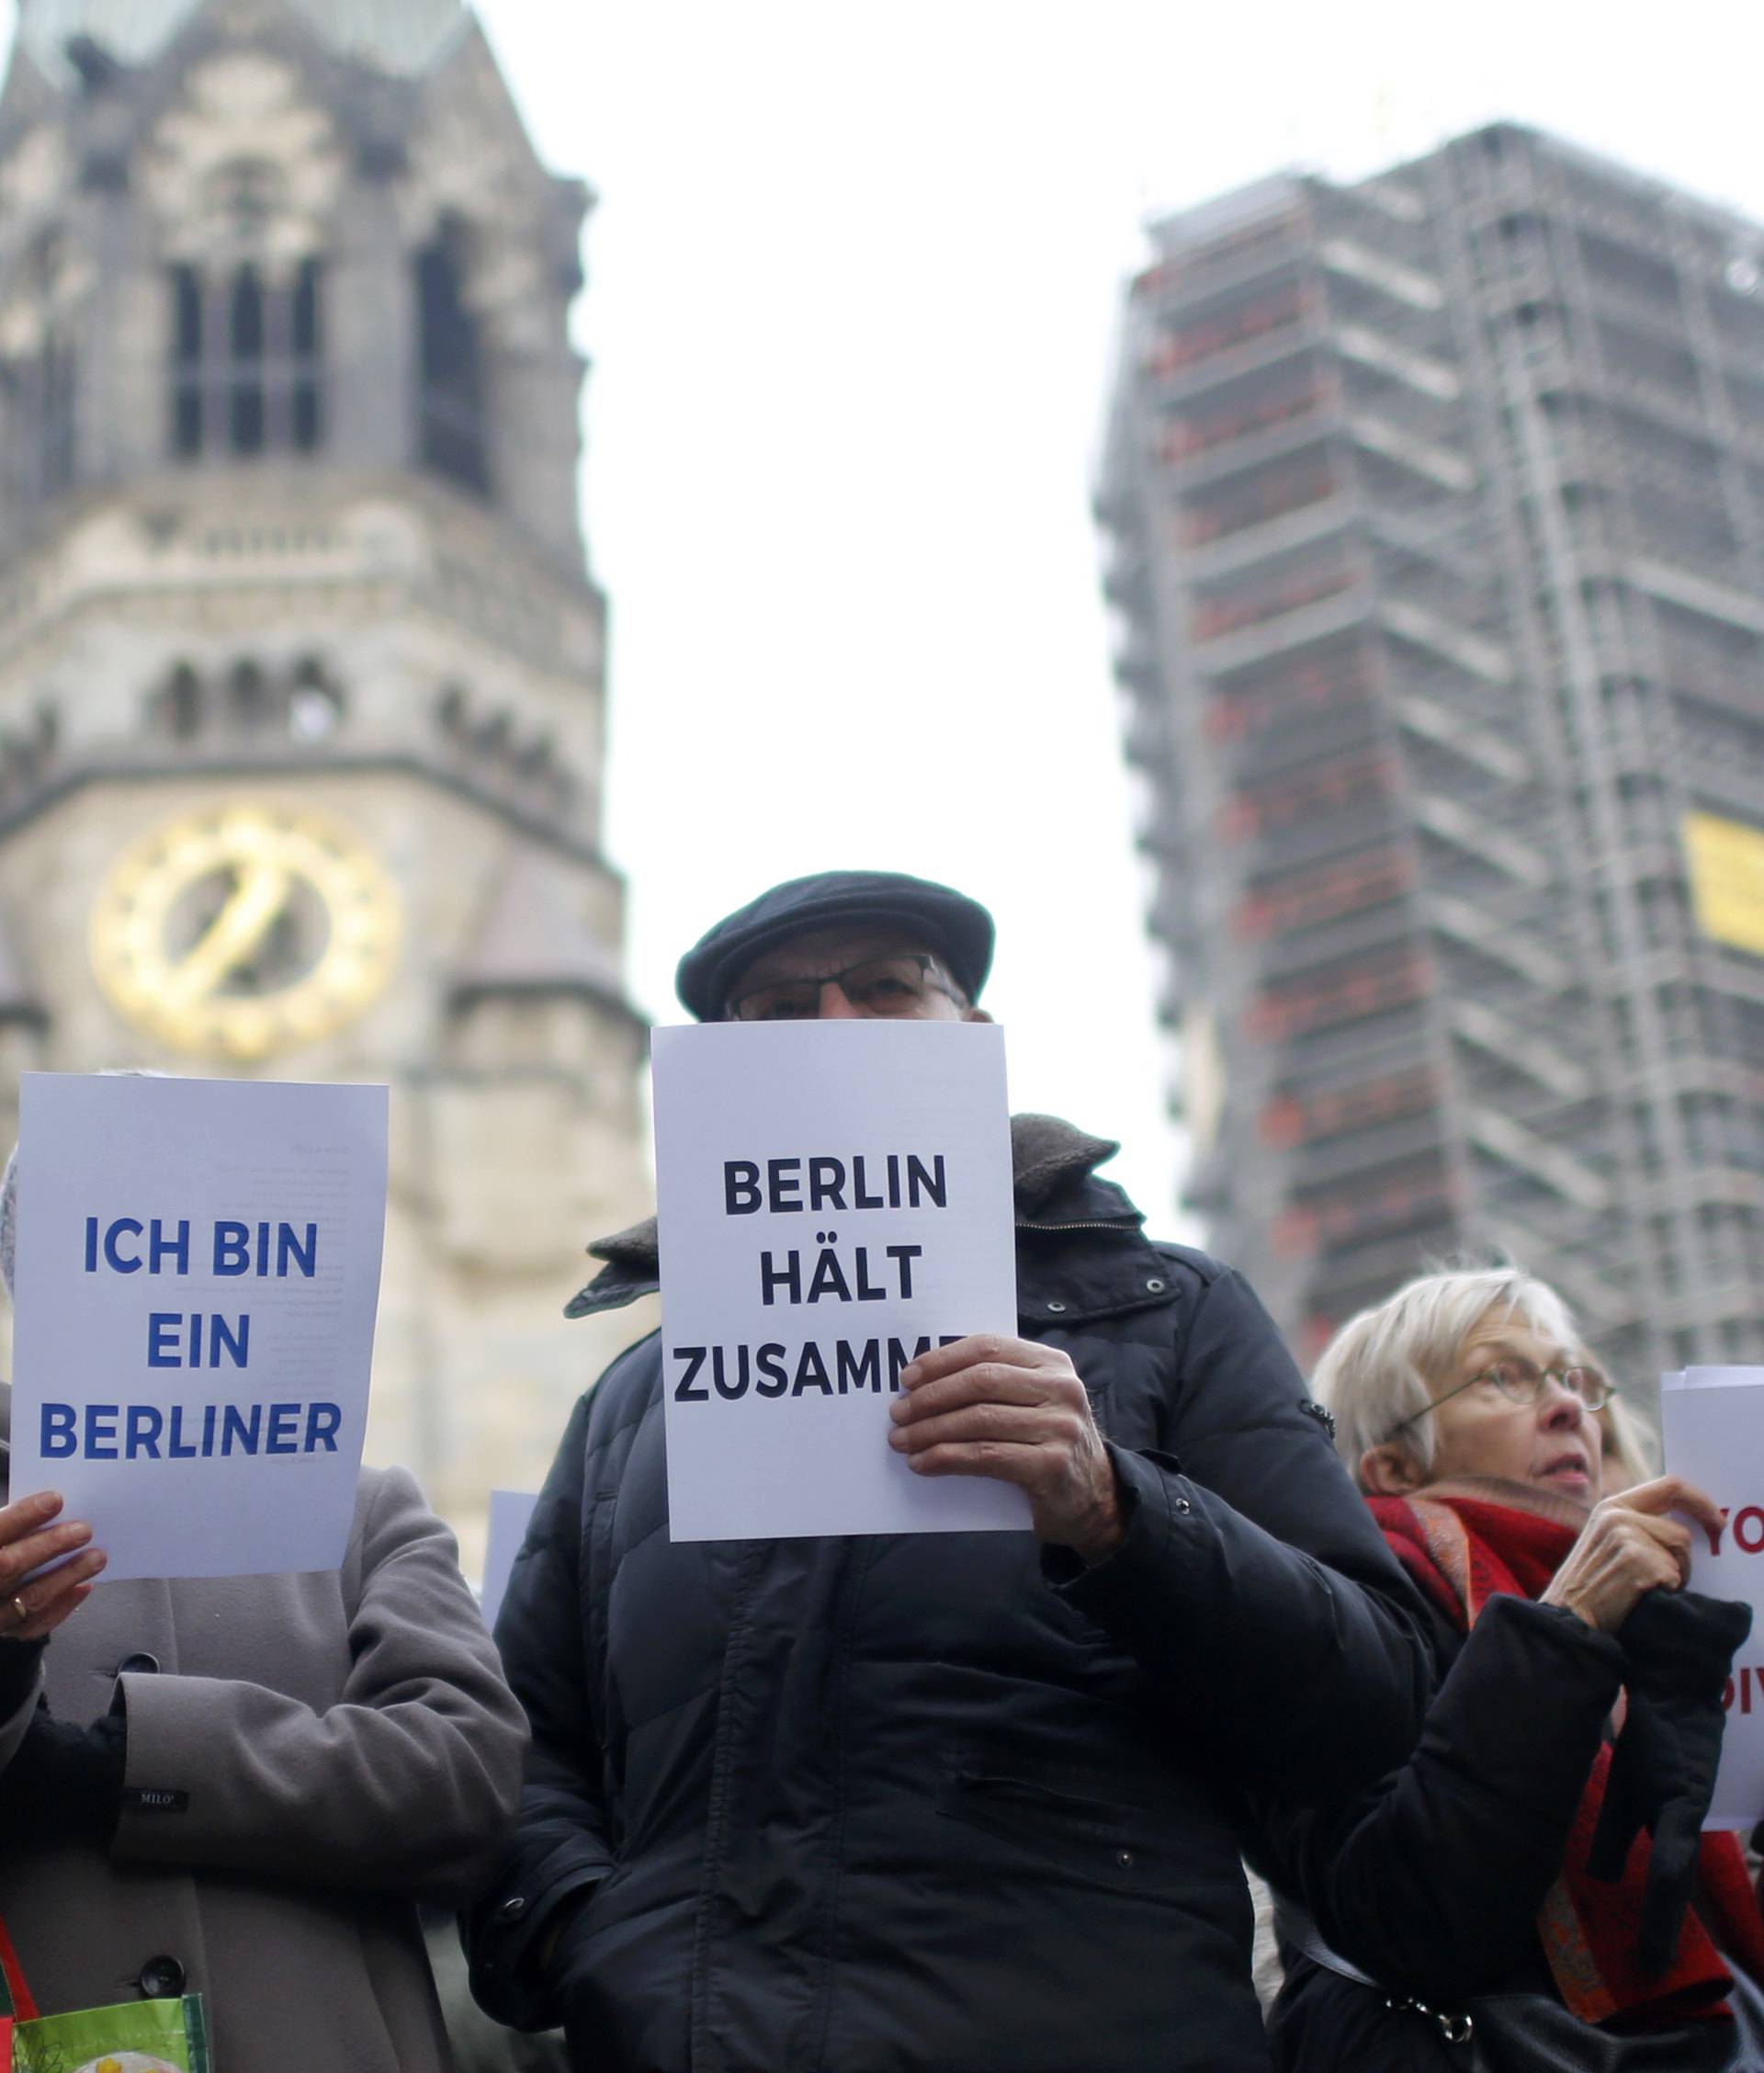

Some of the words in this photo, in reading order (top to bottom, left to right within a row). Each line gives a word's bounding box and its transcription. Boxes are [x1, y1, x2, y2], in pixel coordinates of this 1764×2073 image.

[724, 1154, 947, 1216] BERLIN
[85, 1217, 190, 1275] ICH
[212, 1220, 318, 1278] BIN
[760, 1230, 922, 1306] HÄLT
[147, 1312, 250, 1368] EIN
[673, 1335, 968, 1402] ZUSAMM
[40, 1402, 342, 1460] BERLINER
